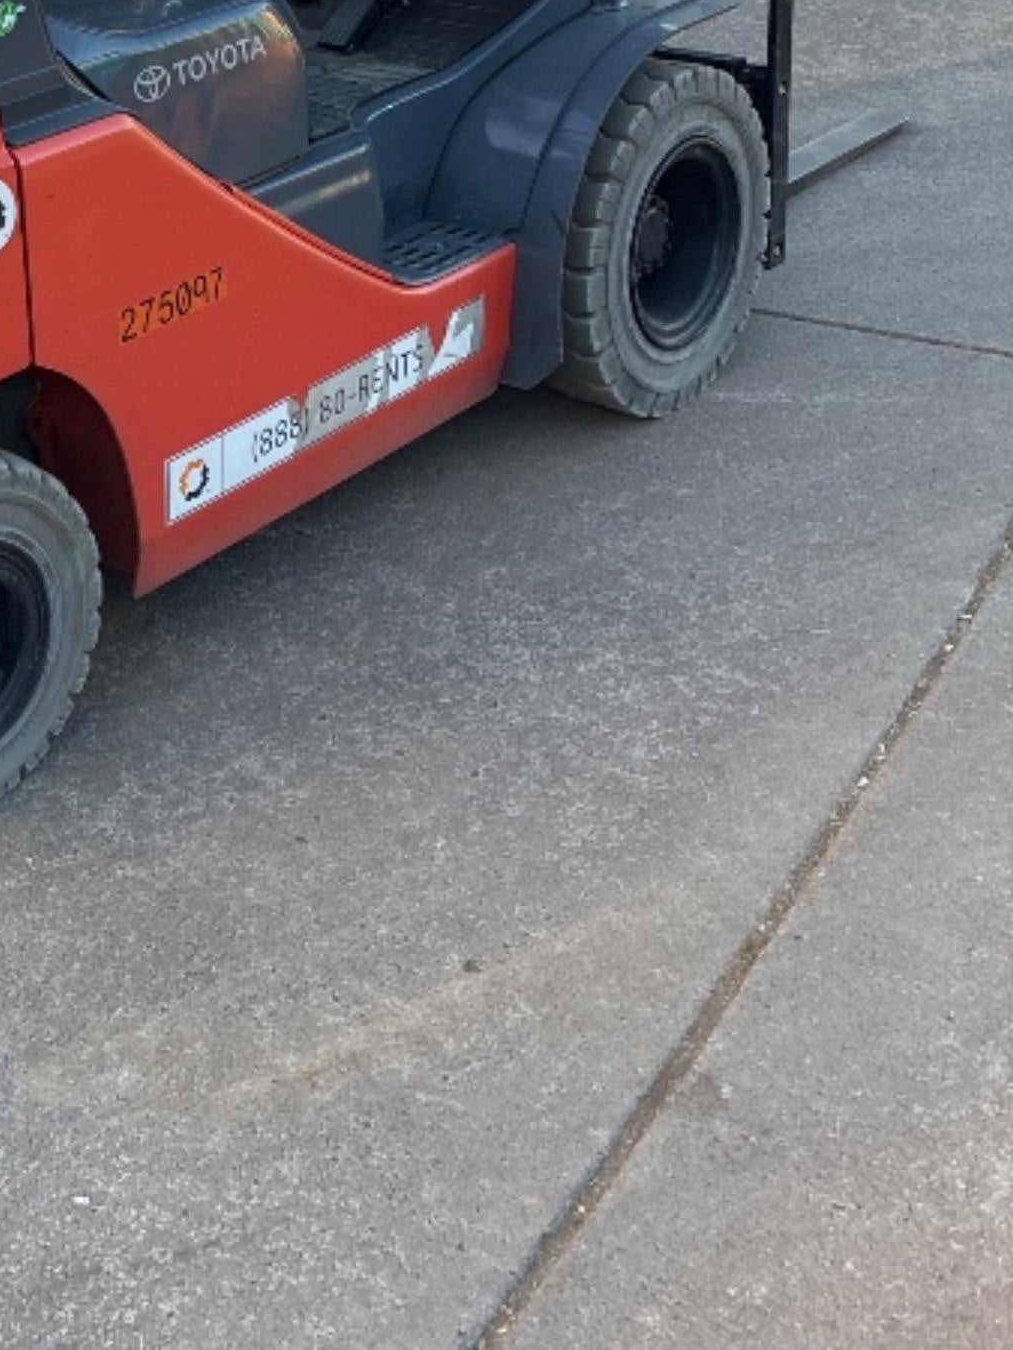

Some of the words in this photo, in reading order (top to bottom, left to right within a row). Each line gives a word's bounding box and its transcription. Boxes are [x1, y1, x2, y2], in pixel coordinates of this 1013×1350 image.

[172, 35, 267, 86] TOYOTA
[121, 266, 222, 343] 275097
[252, 407, 308, 463] (888)
